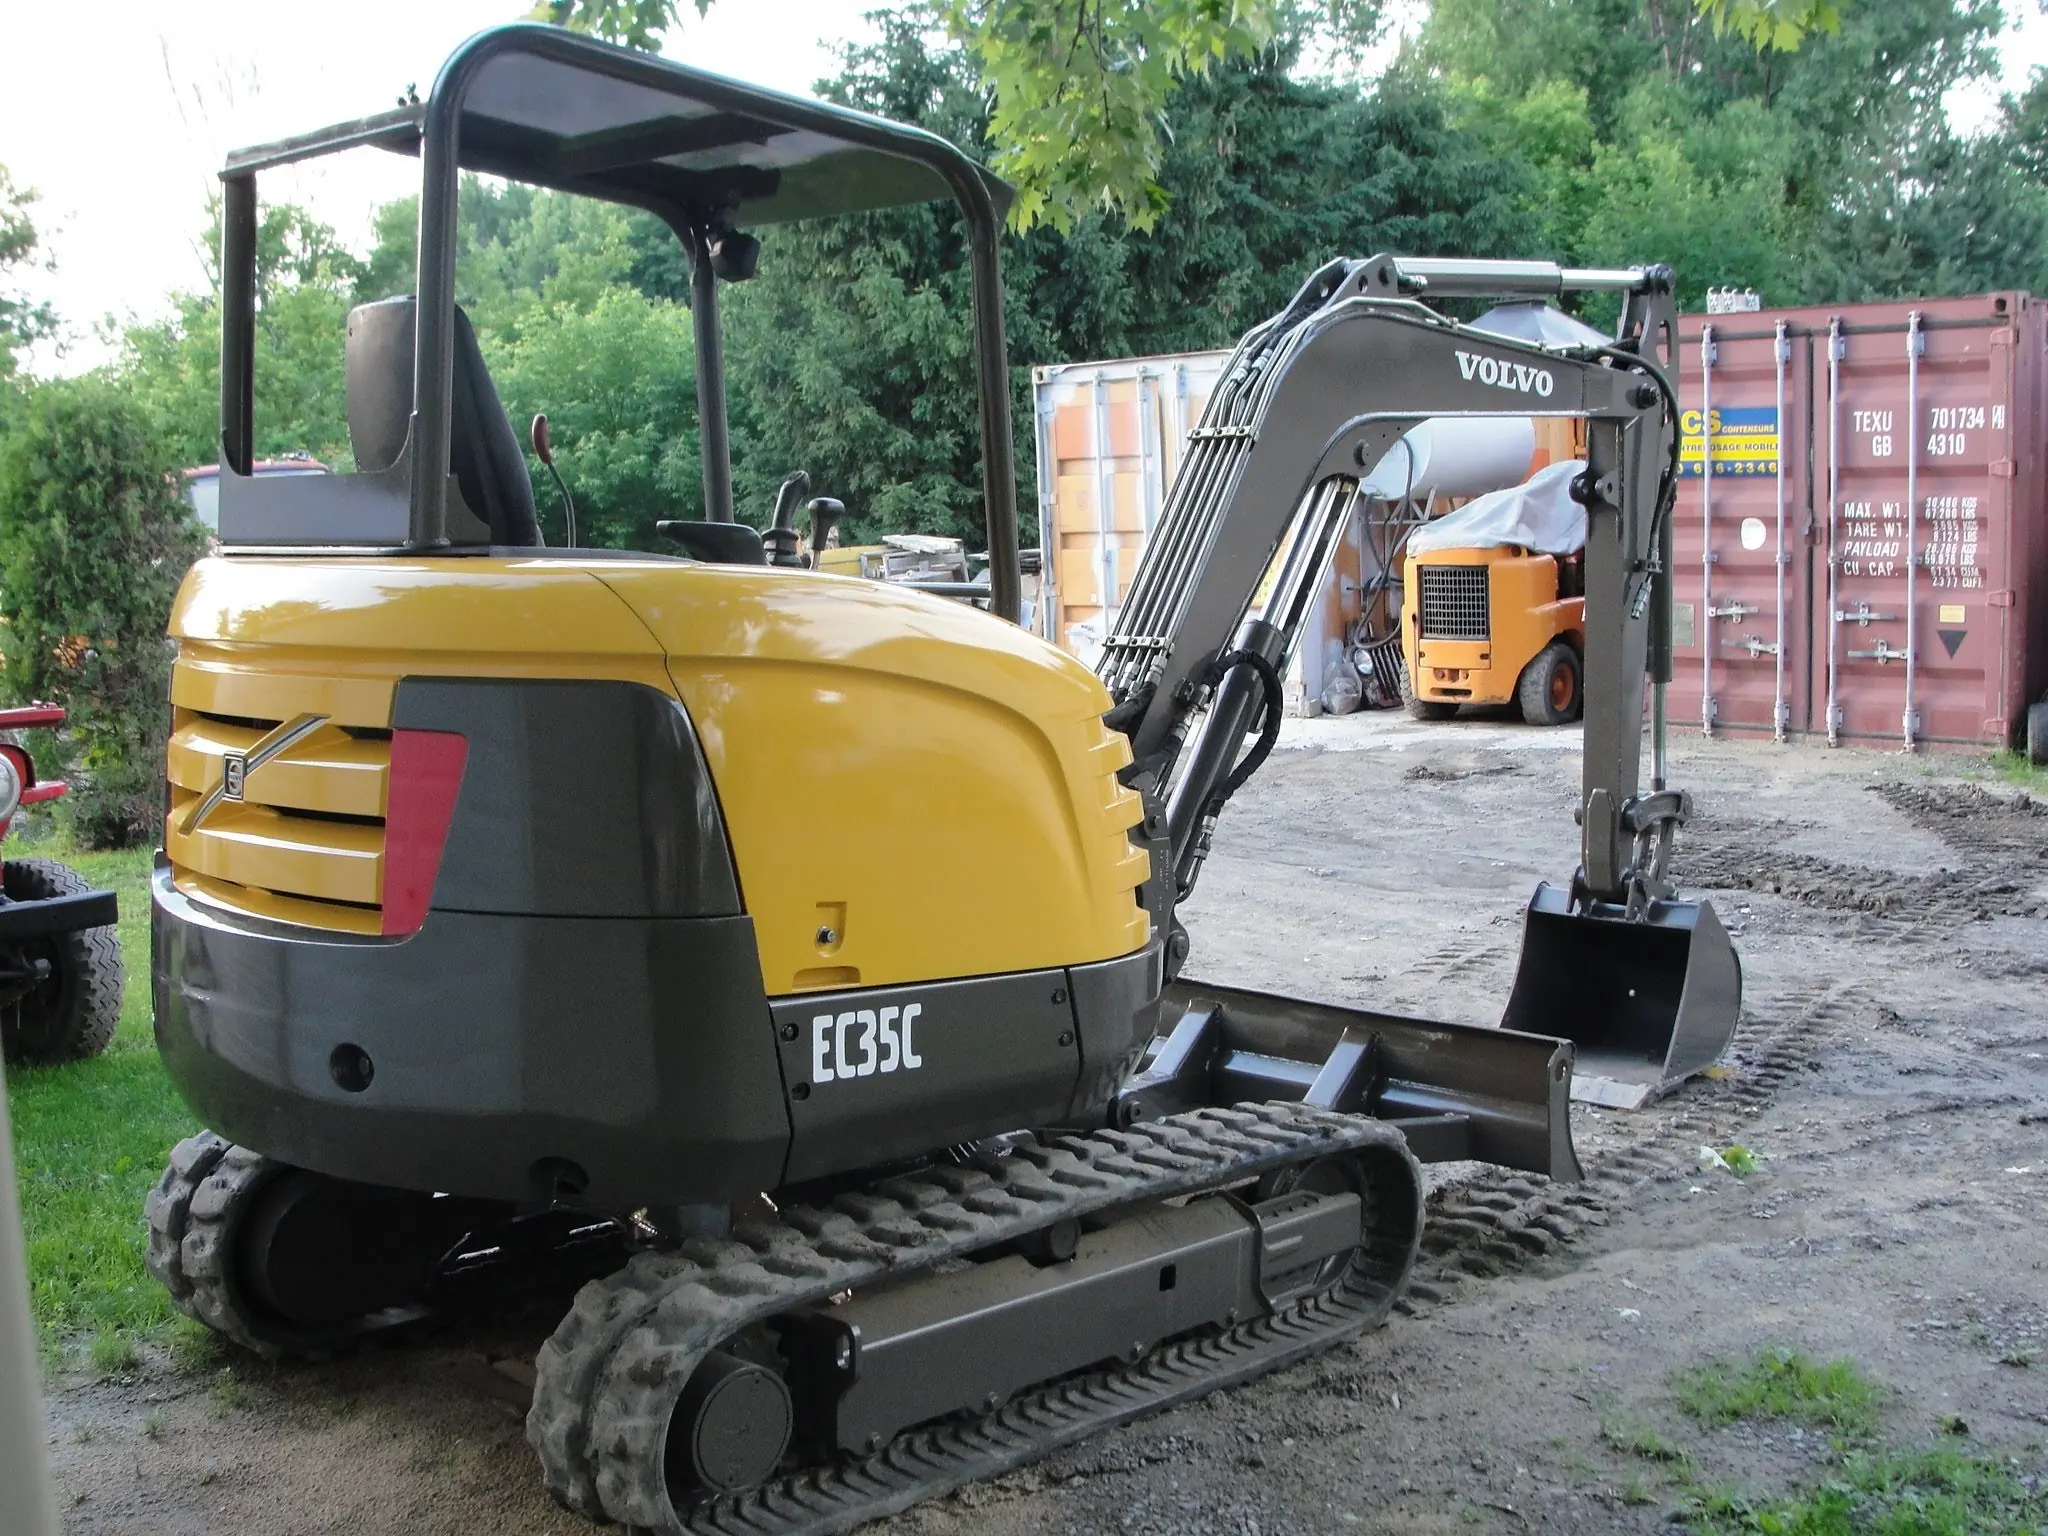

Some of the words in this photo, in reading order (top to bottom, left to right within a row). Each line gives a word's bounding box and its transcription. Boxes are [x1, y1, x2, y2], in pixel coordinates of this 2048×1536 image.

[1455, 351, 1553, 397] VOLVO
[1853, 410, 1893, 432] TEXU
[1931, 407, 1985, 429] 701734
[1722, 424, 1775, 433] CONTENEURS
[1872, 435, 1892, 457] GB
[1927, 433, 1965, 456] 4310
[1844, 502, 1876, 518] MAX.
[1846, 522, 1877, 537] TARE
[1963, 531, 1977, 542] LBS
[1844, 541, 1900, 557] PAYLOAD
[1961, 543, 1977, 554] KGS
[1960, 553, 1975, 565] LBS
[813, 1003, 922, 1084] EC35C
